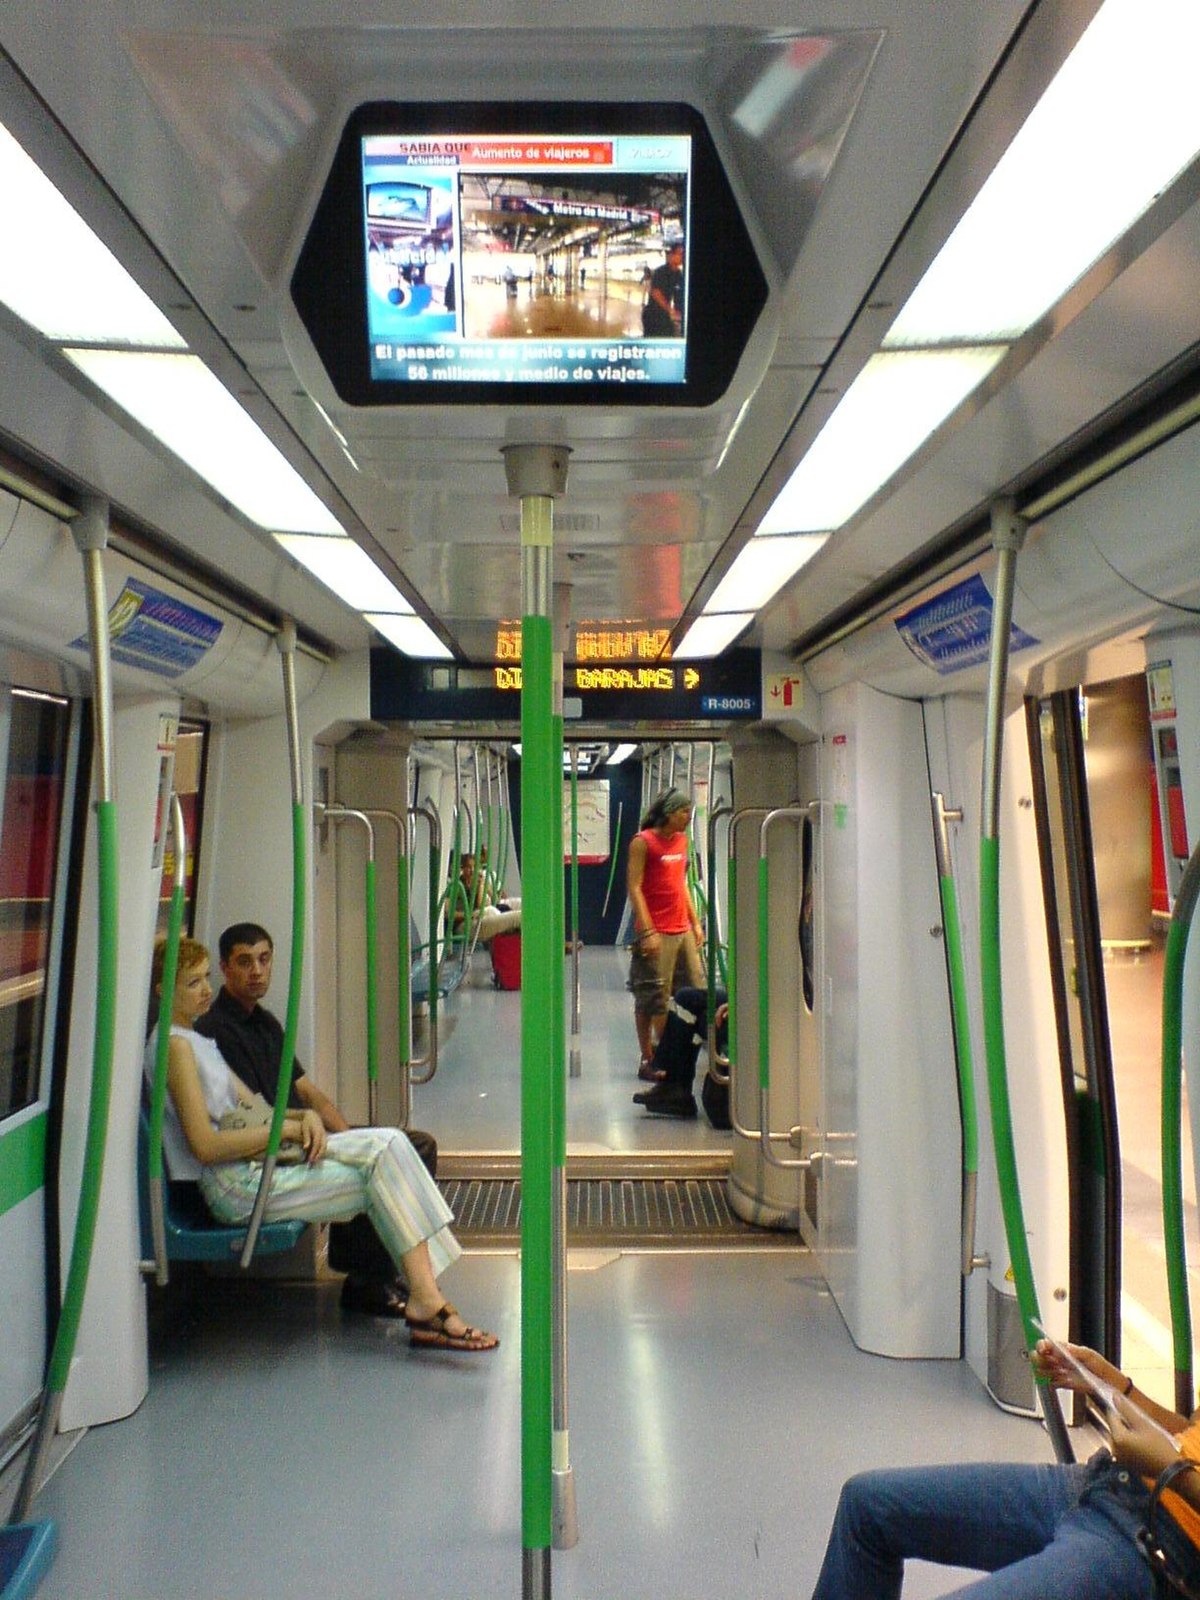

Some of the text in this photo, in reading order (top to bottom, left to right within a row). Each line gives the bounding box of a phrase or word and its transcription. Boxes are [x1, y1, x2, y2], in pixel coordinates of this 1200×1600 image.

[471, 146, 590, 160] Aumento de viajeros
[553, 202, 582, 216] Metro
[584, 206, 597, 217] de
[598, 205, 628, 220] Madrid
[375, 344, 393, 360] El
[396, 344, 455, 362] pasado
[522, 344, 564, 362] junio
[567, 346, 587, 360] se
[591, 345, 683, 363] registraron
[432, 364, 501, 381] millones
[504, 368, 515, 383] y
[518, 366, 569, 381] medio
[572, 366, 594, 381] de
[597, 366, 651, 383] viajes.
[576, 667, 674, 690] BARAJAS
[707, 697, 752, 710] R-8005
